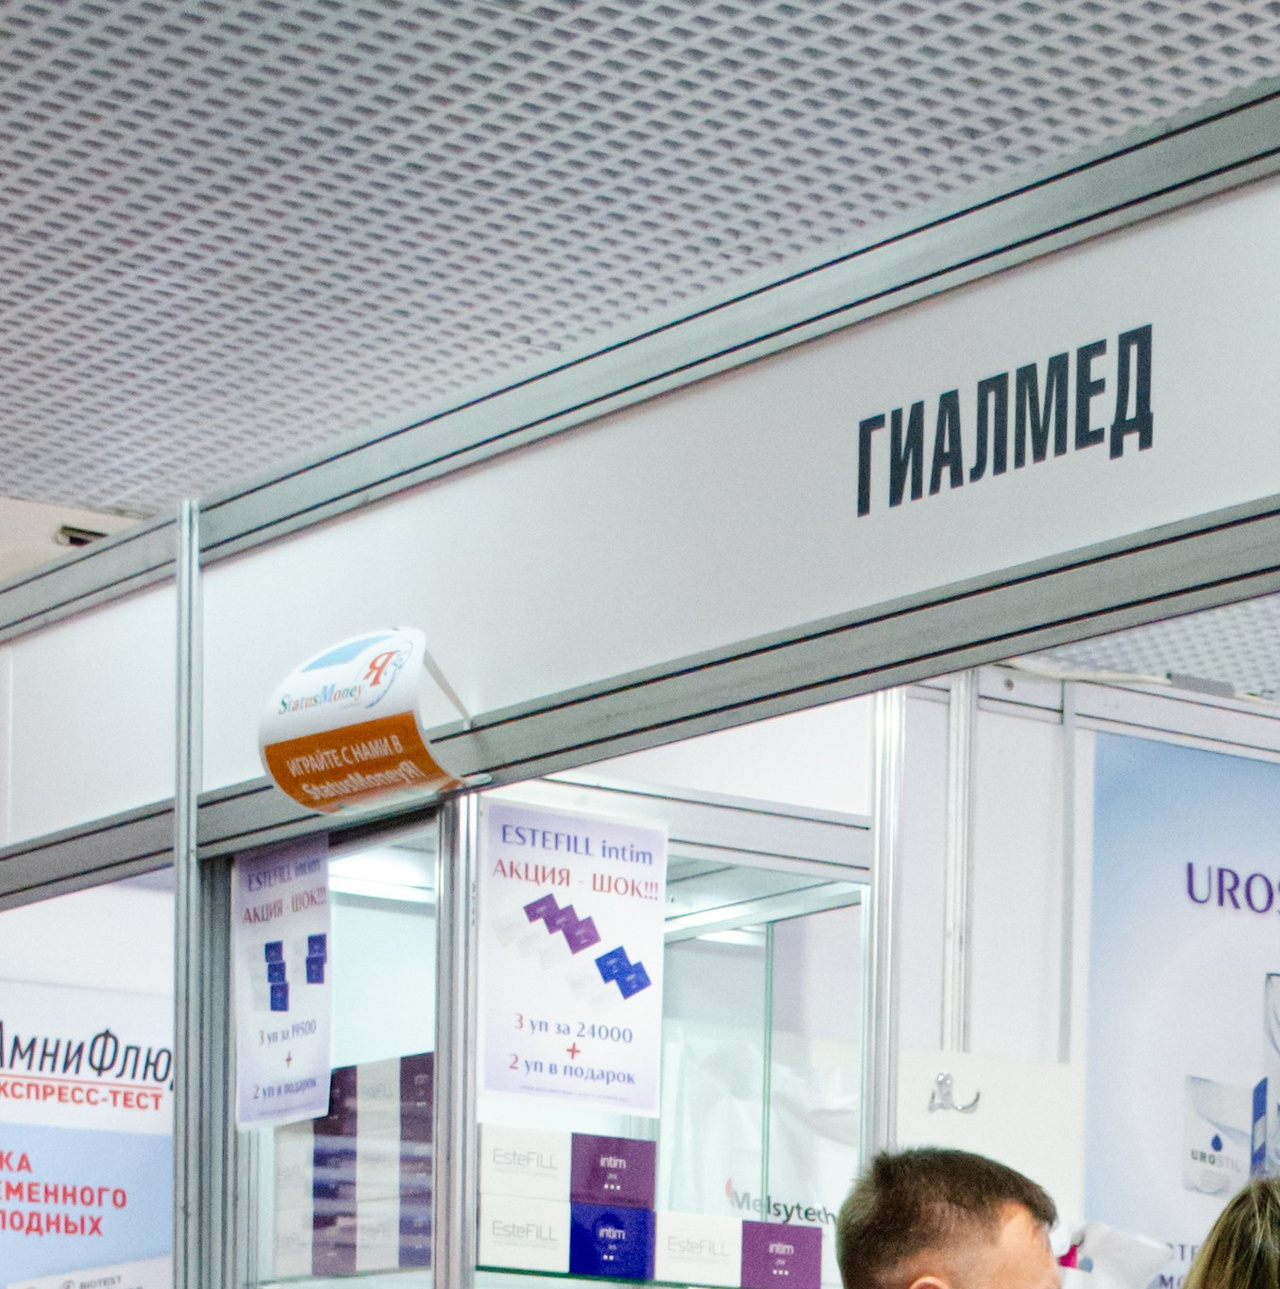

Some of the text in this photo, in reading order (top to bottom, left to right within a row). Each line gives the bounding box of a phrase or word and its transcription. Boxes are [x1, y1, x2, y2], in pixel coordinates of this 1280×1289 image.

[858, 323, 1154, 518] ГИАЛМЕД
[286, 734, 404, 778] ИГРАЙТЕ С НАМИ В
[501, 823, 653, 866] ESTEFILL intim
[493, 858, 571, 887] АКЦИЯ
[592, 872, 659, 901] ШОК!!!
[514, 1012, 634, 1044] 3 уп за 24000
[0, 1020, 174, 1092] мниФлю
[566, 1041, 581, 1061] +
[508, 1053, 637, 1086] 2 уп в подарок
[492, 1148, 559, 1171] EsteFILL
[600, 1154, 627, 1169] intim
[0, 1179, 128, 1210] МЕННОГО
[492, 1220, 559, 1242] EsteFILL
[598, 1226, 626, 1241] intim
[666, 1235, 731, 1258] EsteFILL
[768, 1241, 795, 1256] intim
